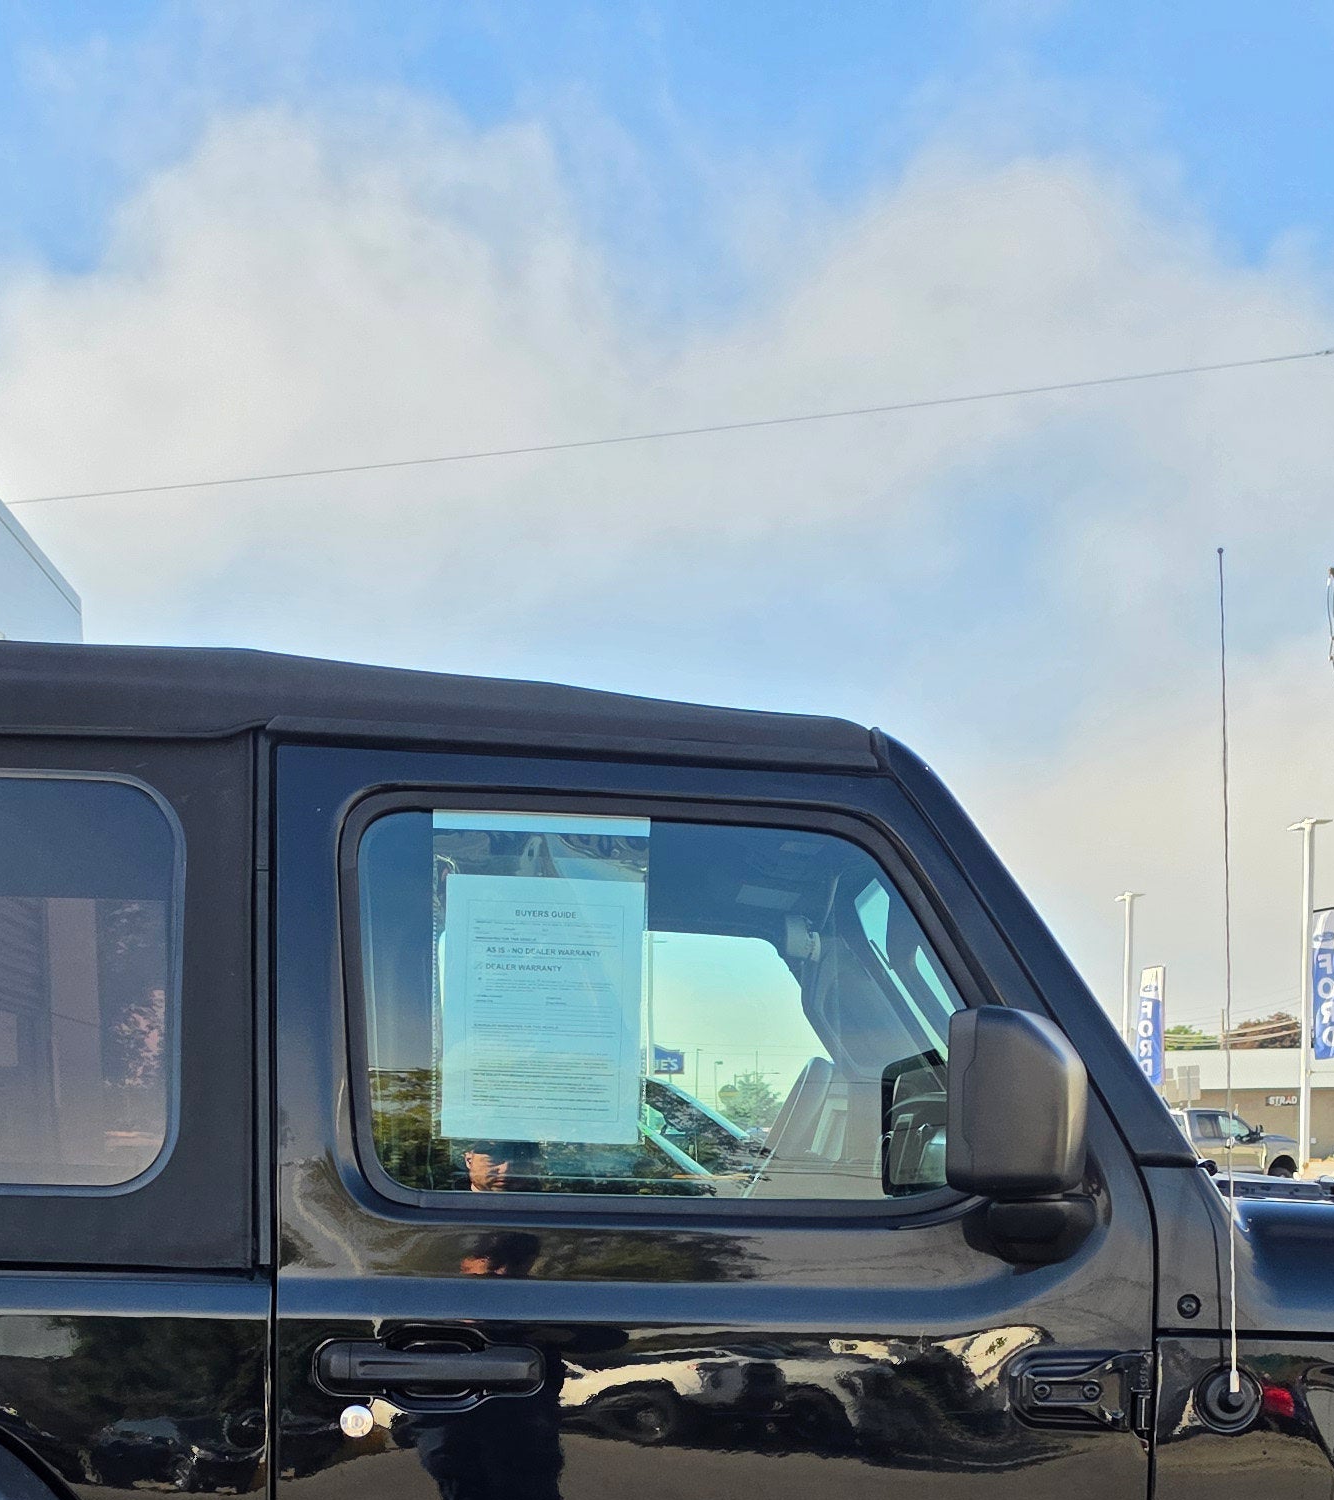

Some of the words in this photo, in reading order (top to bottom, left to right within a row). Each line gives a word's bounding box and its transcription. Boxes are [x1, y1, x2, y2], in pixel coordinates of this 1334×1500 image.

[515, 909, 549, 918] BUYERS
[551, 911, 577, 919] GUIDE
[558, 949, 601, 957] WARRANTY
[486, 963, 517, 971] DEALER
[519, 964, 563, 972] WARRANTY
